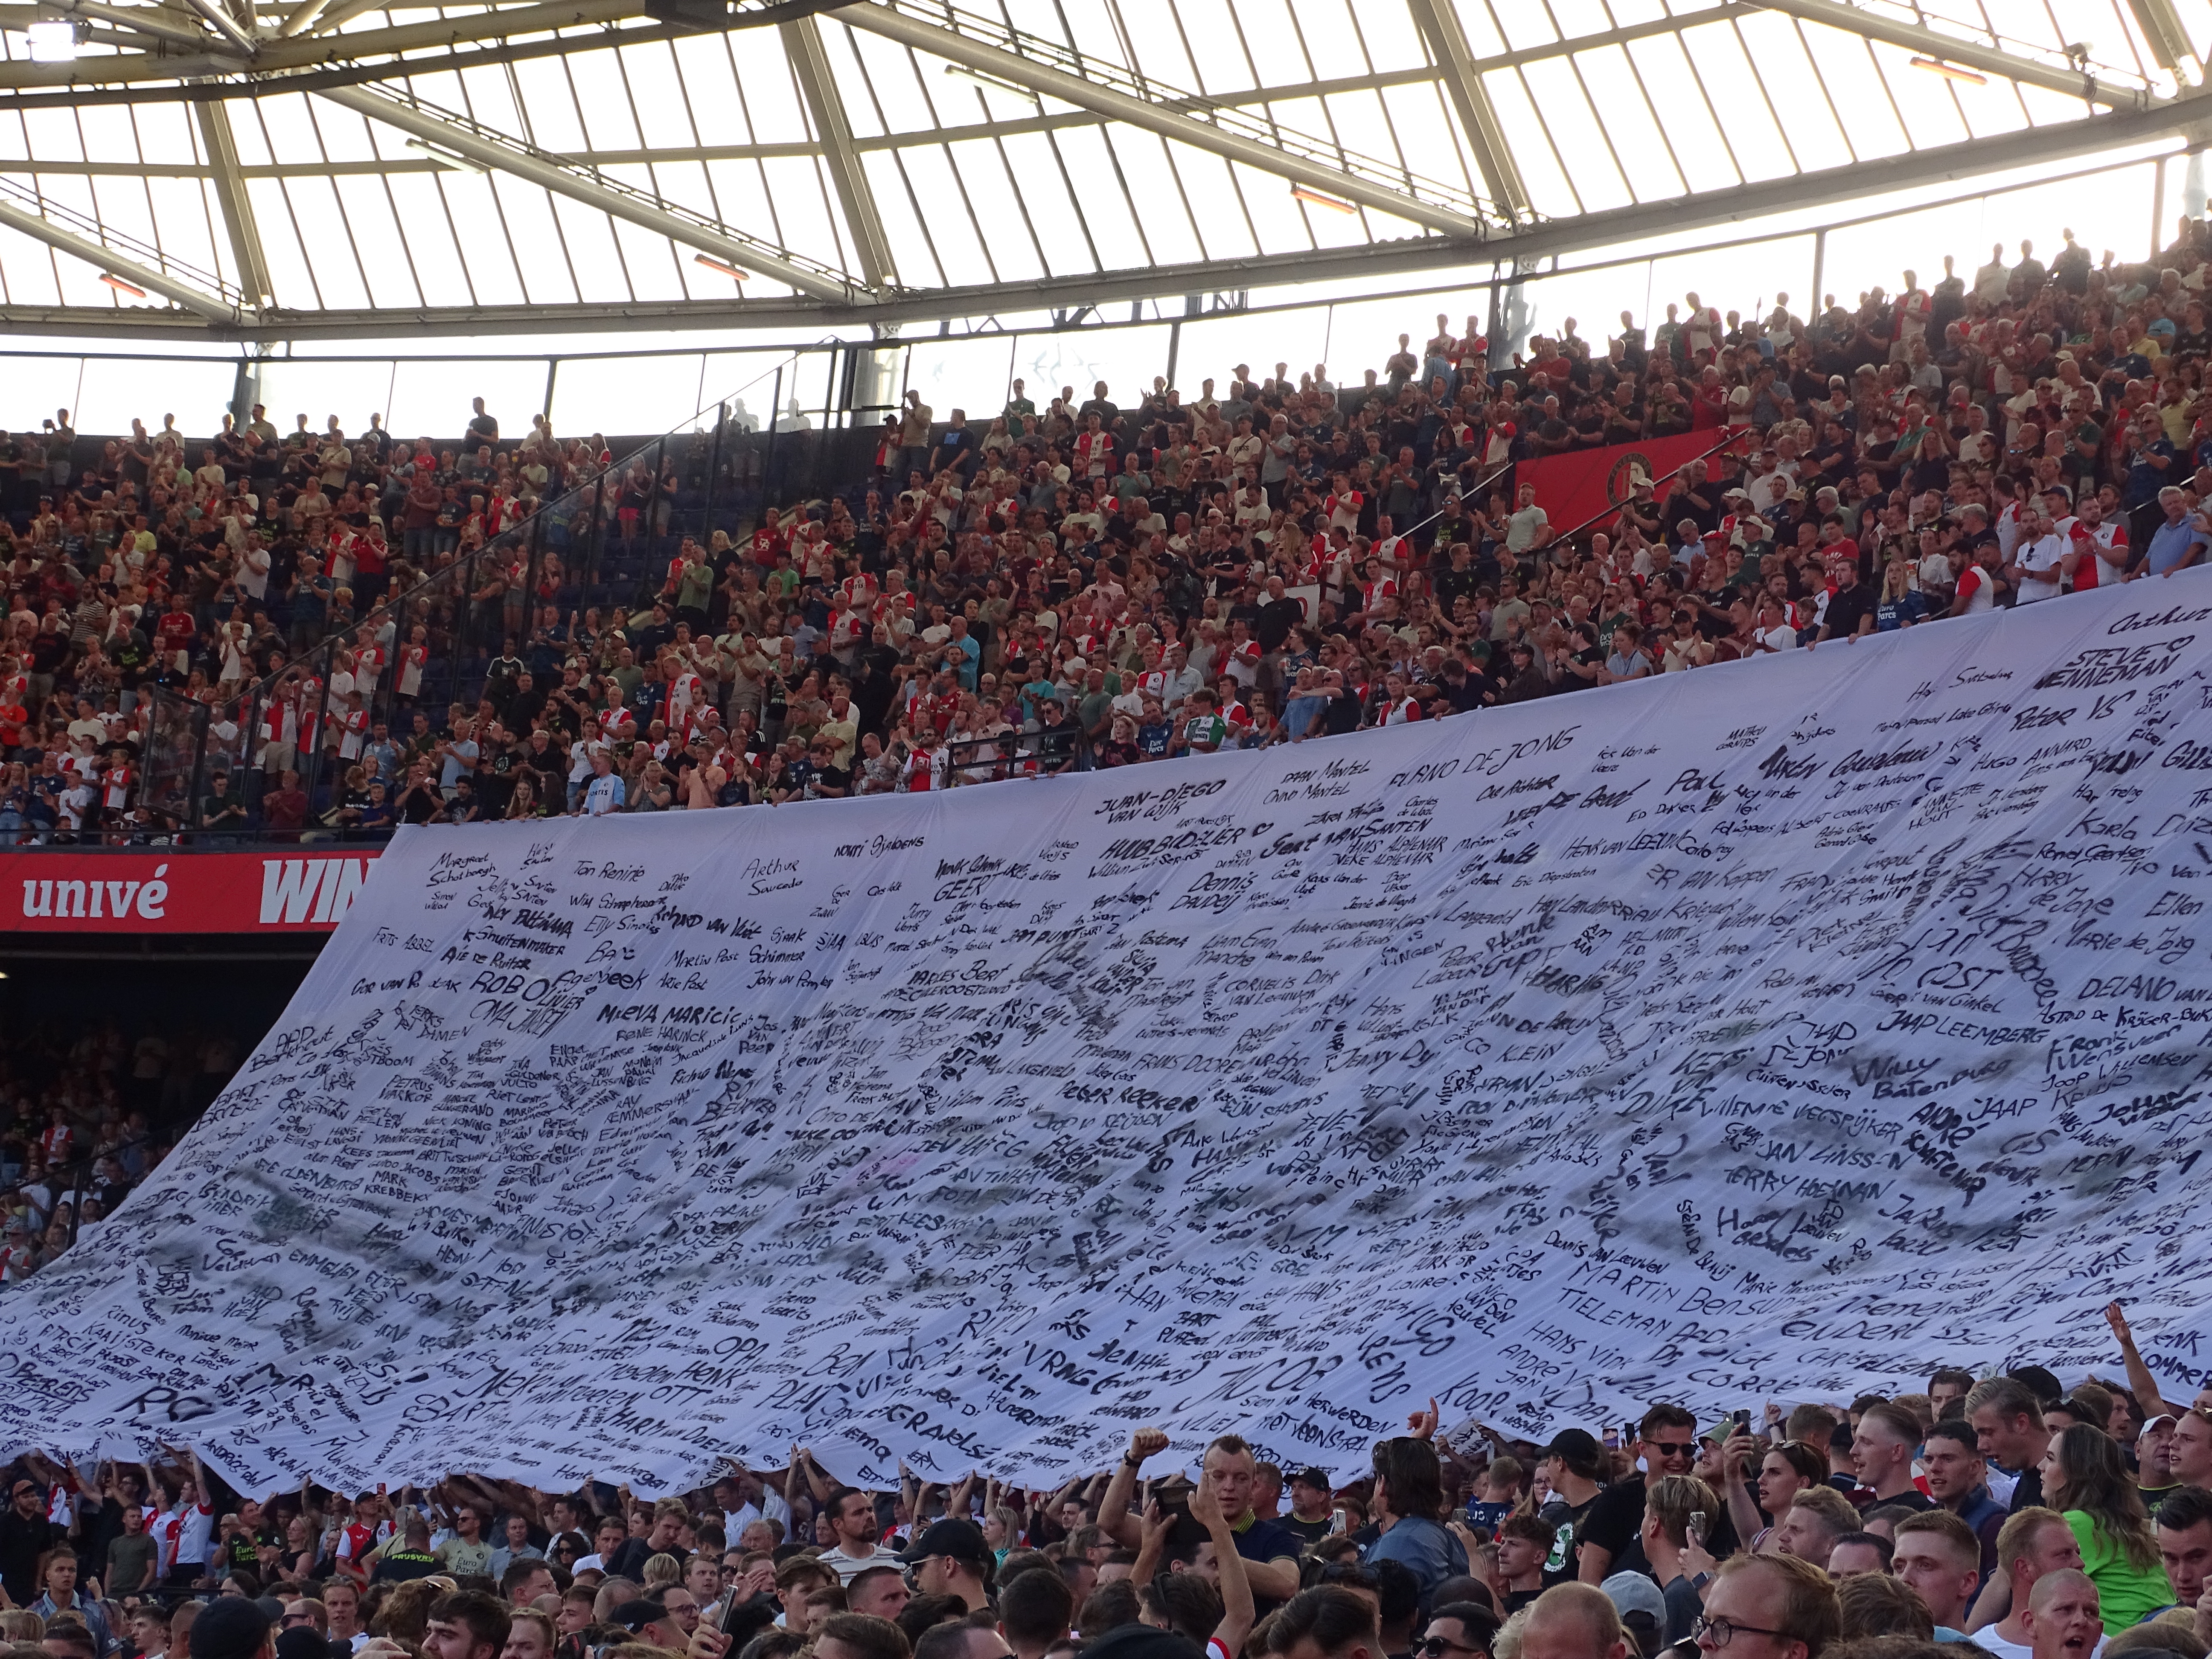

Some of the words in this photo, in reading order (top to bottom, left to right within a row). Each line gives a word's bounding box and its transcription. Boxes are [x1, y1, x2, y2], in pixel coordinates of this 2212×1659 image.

[1462, 749, 1502, 774] DE
[1487, 725, 1582, 775] JONG
[1094, 779, 1227, 815] JUAN-DIEGO
[1108, 809, 1141, 824] VAN
[22, 863, 169, 920] univé
[470, 971, 525, 994] ROB
[2078, 974, 2177, 1002] DELANO
[470, 999, 516, 1028] OMA
[1495, 1042, 1566, 1062] KLEIN
[1967, 1096, 2038, 1121] JAAP
[373, 1171, 408, 1187] MARK
[1567, 1260, 1681, 1304] MARTIN
[1464, 1291, 1489, 1308] VAN
[1479, 1283, 1518, 1310] NICO
[1558, 1286, 1672, 1339] TIELEMAN
[713, 1336, 770, 1366] OPA
[1522, 1320, 1587, 1355] HANS
[1496, 1369, 1542, 1391] JAN
[457, 1557, 477, 1567] Euro
